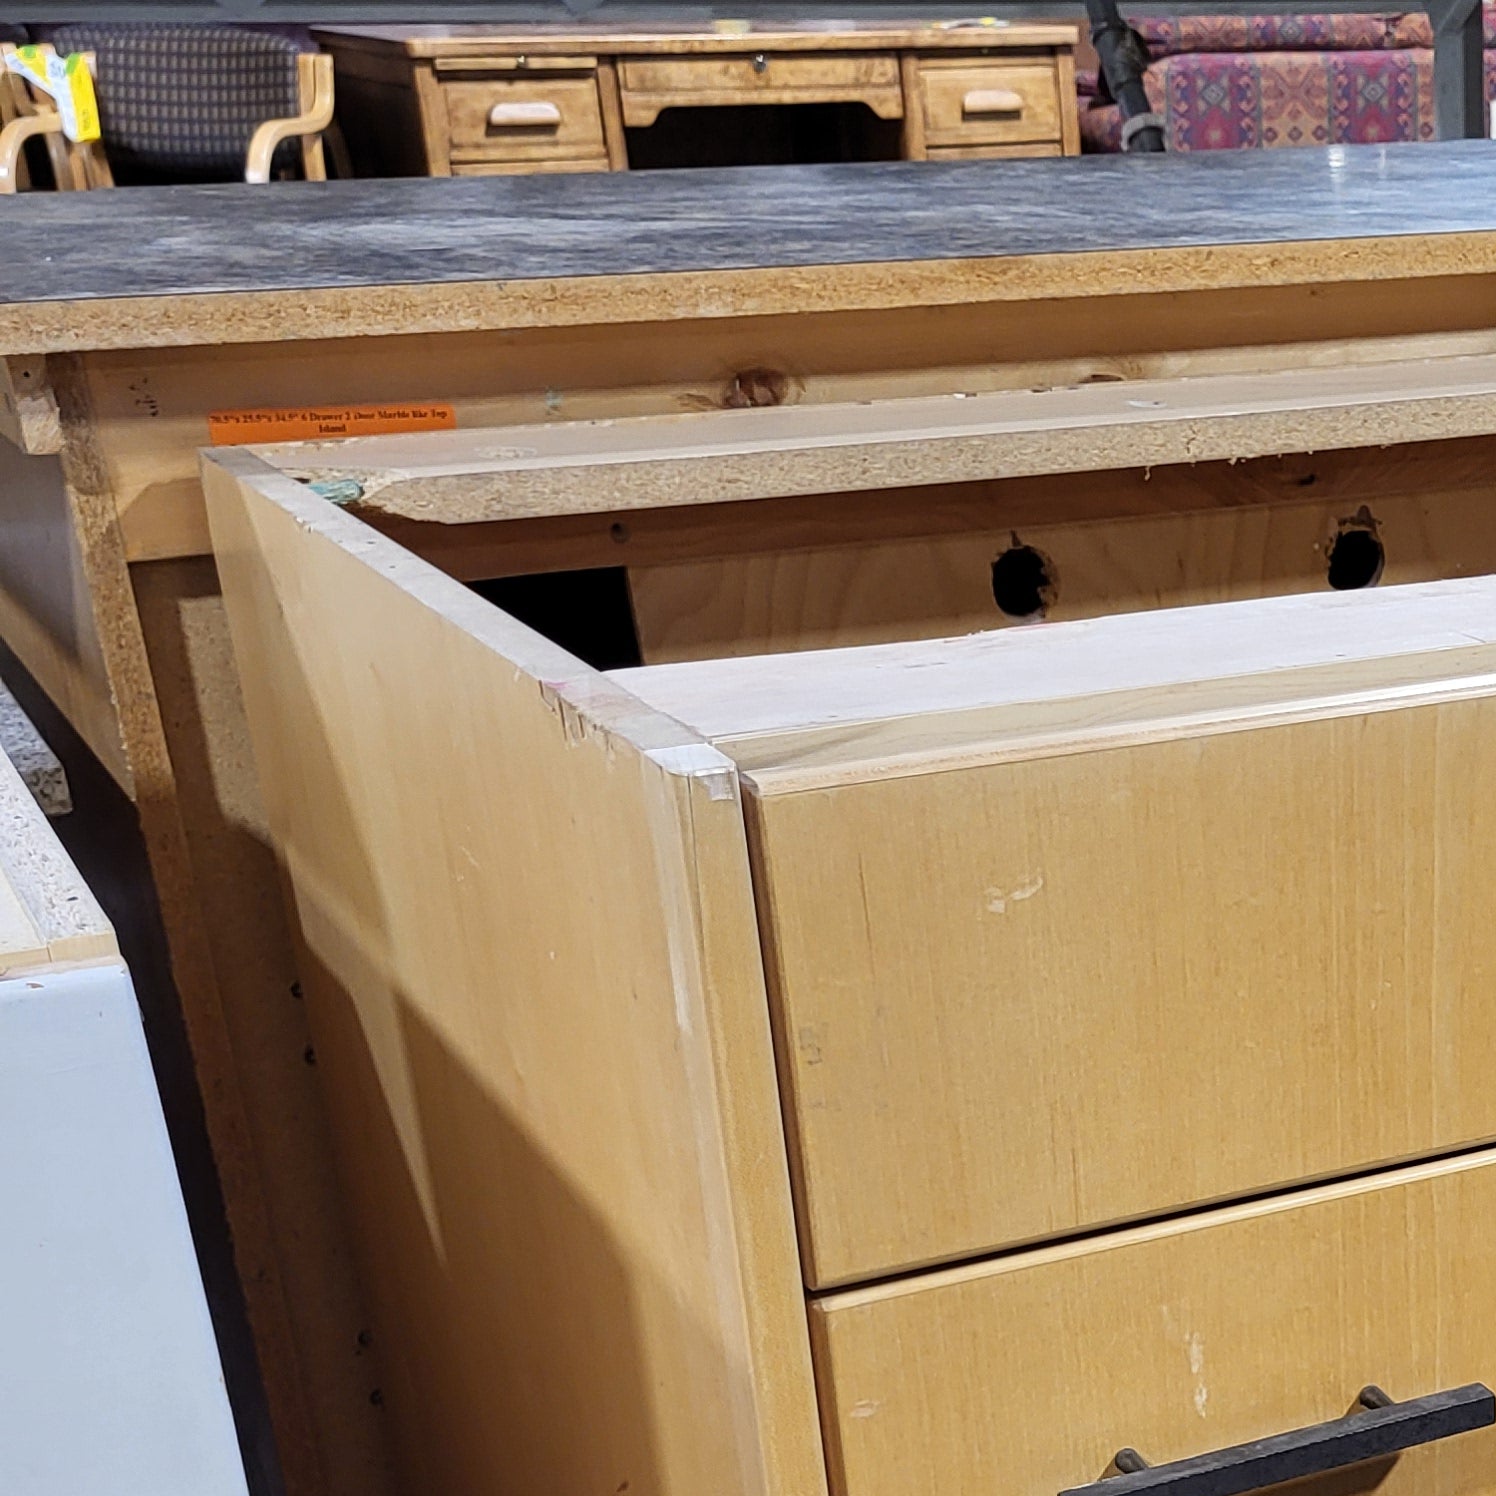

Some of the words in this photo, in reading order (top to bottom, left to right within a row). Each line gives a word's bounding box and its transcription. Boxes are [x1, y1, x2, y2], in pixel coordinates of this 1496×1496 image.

[309, 412, 342, 421] Drawer
[378, 410, 410, 419] Marble
[431, 408, 448, 419] Top
[319, 423, 346, 433] Island
